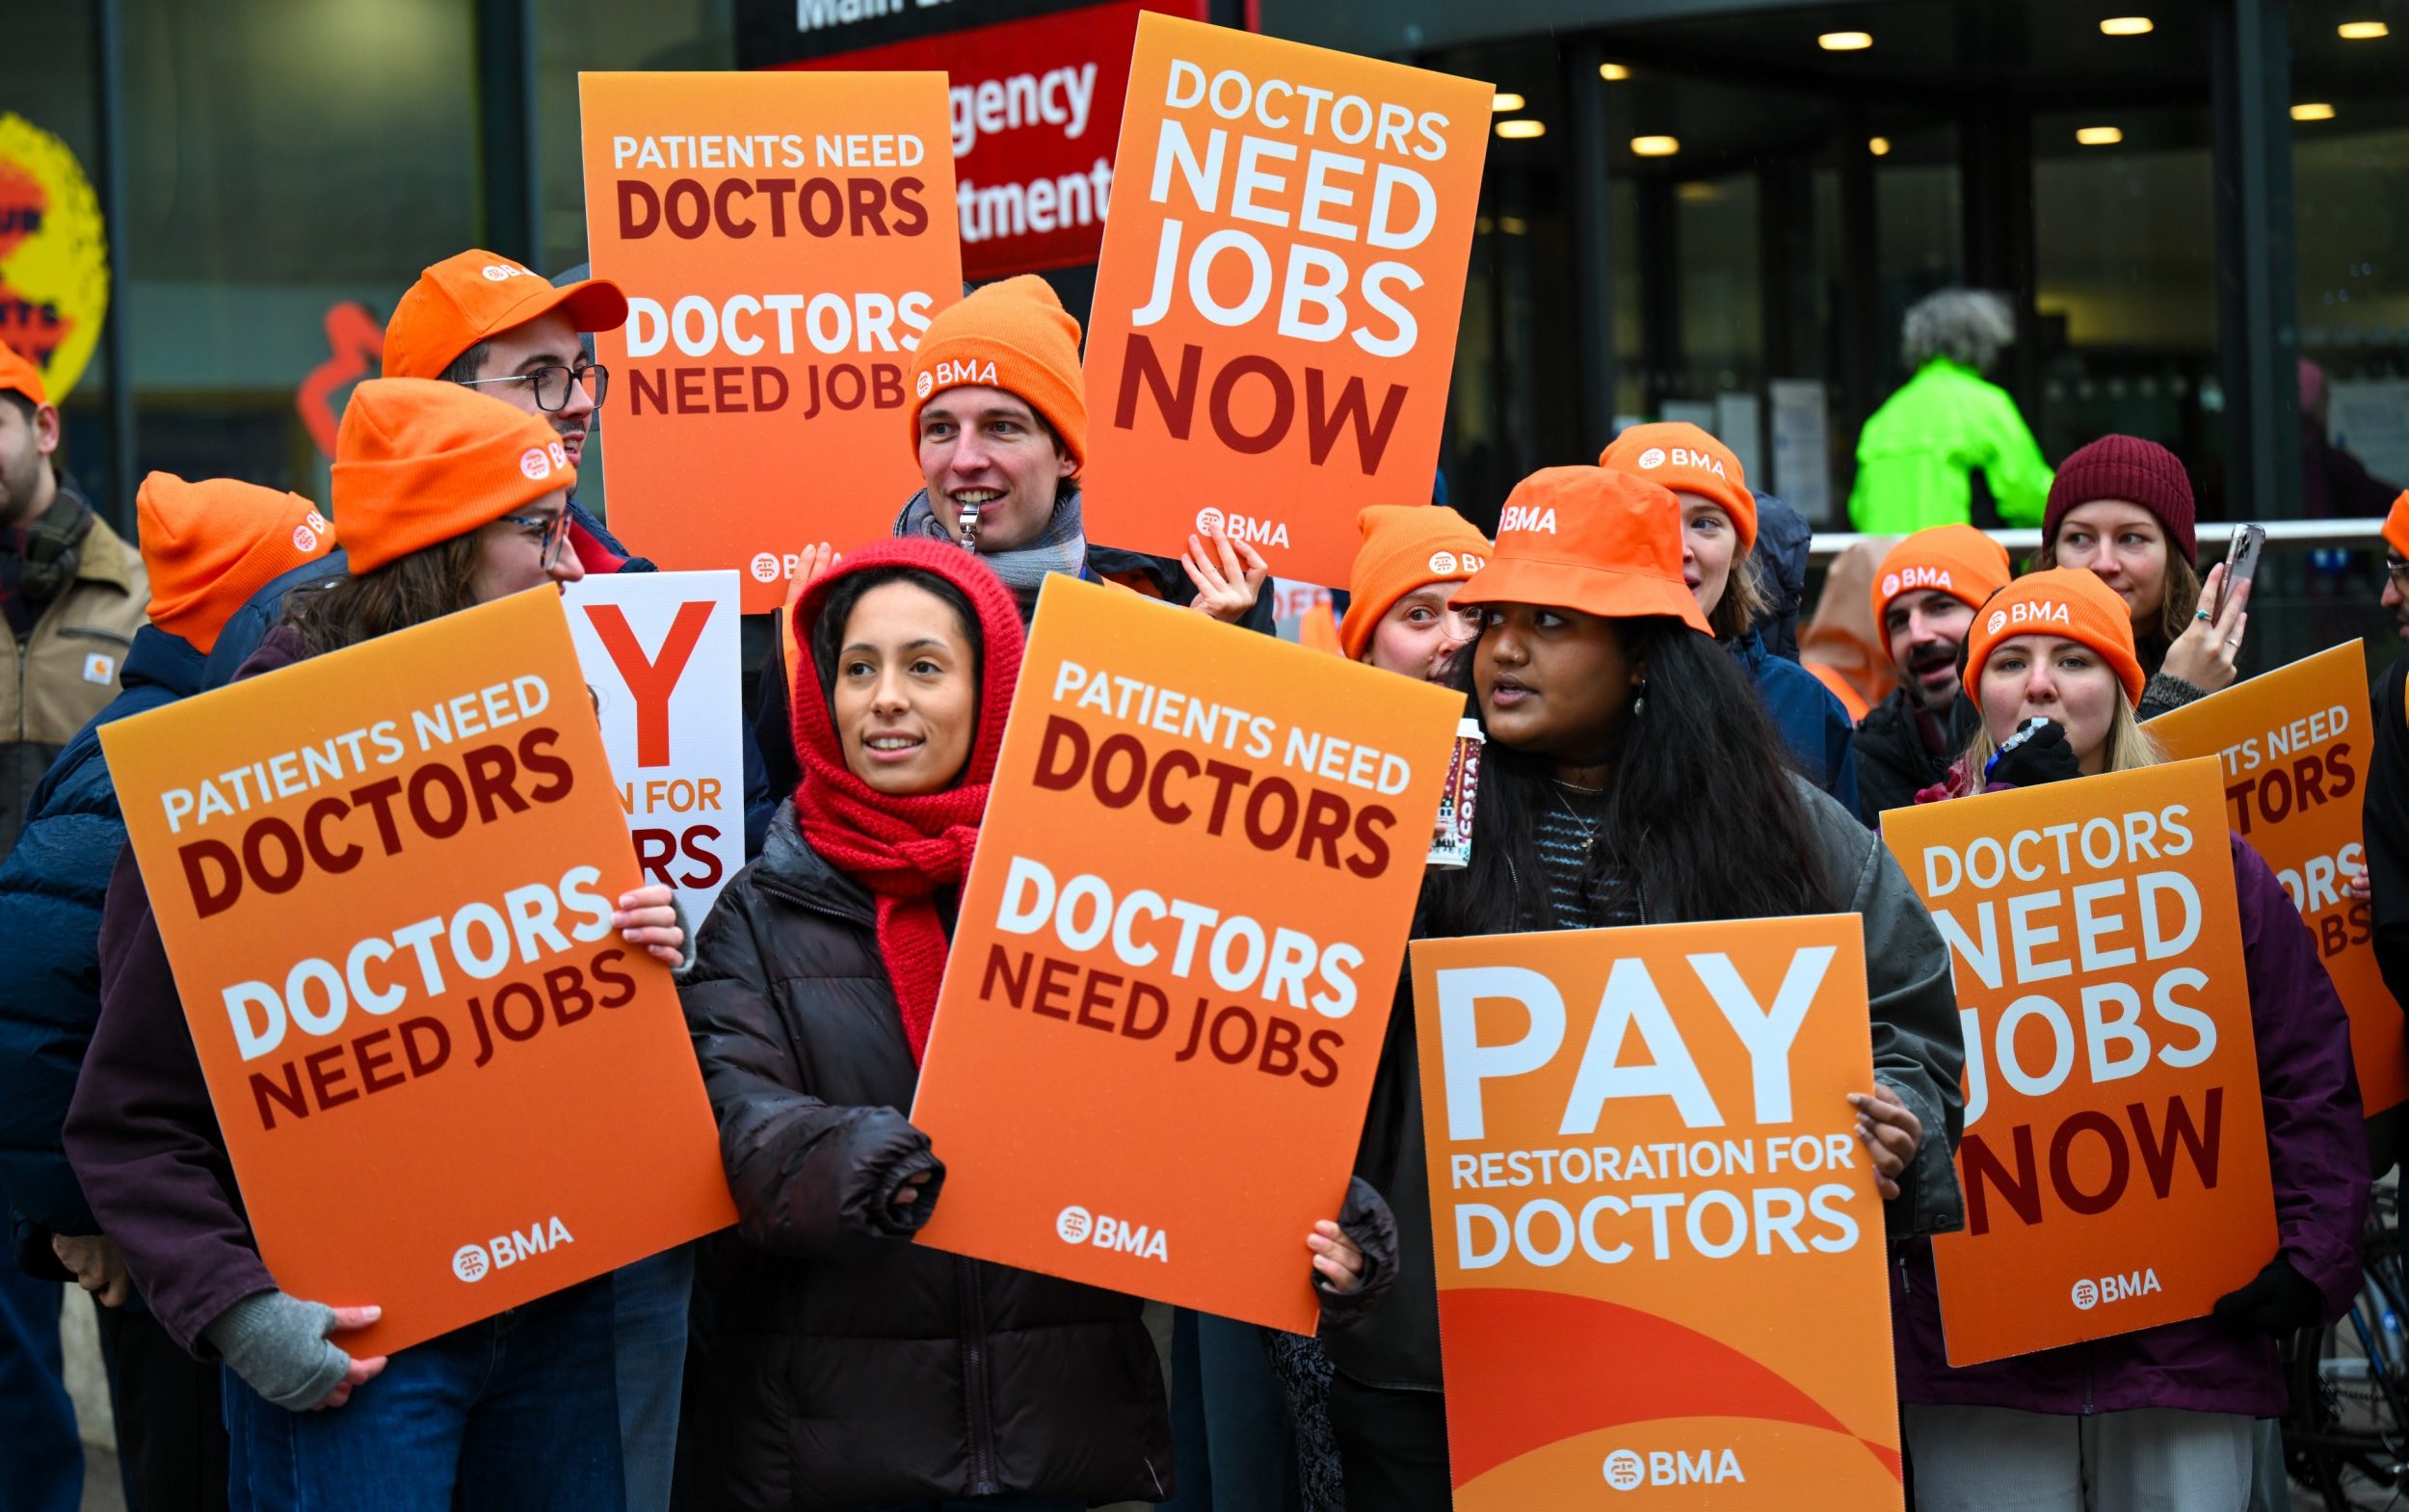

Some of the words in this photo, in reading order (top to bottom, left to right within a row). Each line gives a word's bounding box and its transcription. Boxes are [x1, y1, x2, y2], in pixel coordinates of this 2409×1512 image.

[614, 135, 805, 169] PATIENTS
[815, 134, 924, 167] NEED
[1165, 59, 1449, 161] DOCTORS
[618, 177, 928, 239] DOCTORS
[1150, 119, 1437, 250] NEED
[625, 291, 933, 358] DOCTORS
[1132, 218, 1424, 358] JOBS
[629, 367, 788, 414] NEED
[805, 364, 905, 419] JOB
[937, 358, 998, 385] BMA
[1115, 333, 1408, 475] NOW
[1672, 448, 1726, 480] BMA
[1227, 514, 1289, 548] BMA
[1502, 506, 1556, 535] BMA
[1902, 567, 1952, 589] BMA
[2012, 601, 2070, 624] BMA
[161, 721, 404, 833] PATIENTS
[411, 675, 549, 751] NEED
[1053, 660, 1276, 758] PATIENTS
[1284, 727, 1411, 795] NEED
[2268, 705, 2348, 759] NEED
[178, 728, 573, 919] DOCTORS
[646, 778, 723, 814] FOR
[1033, 715, 1396, 878] DOCTORS
[1459, 756, 1477, 836] COSTA
[1924, 805, 2193, 896] DOCTORS
[222, 865, 618, 1061] DOCTORS
[996, 856, 1364, 1019] DOCTORS
[1931, 872, 2201, 995] NEED
[248, 1016, 451, 1131] NEED
[467, 928, 638, 1069] JOBS
[980, 944, 1169, 1040] NEED
[1176, 998, 1344, 1087] JOBS
[1437, 945, 1837, 1140] PAY
[1960, 968, 2216, 1127] JOBS
[1451, 1139, 1755, 1188] RESTORATION
[1766, 1134, 1854, 1173] FOR
[1961, 1086, 2224, 1237] NOW
[490, 1217, 573, 1268] BMA
[1093, 1215, 1167, 1262] BMA
[1455, 1183, 1860, 1269] DOCTORS
[2101, 1268, 2162, 1302] BMA
[1650, 1449, 1745, 1486] BMA
